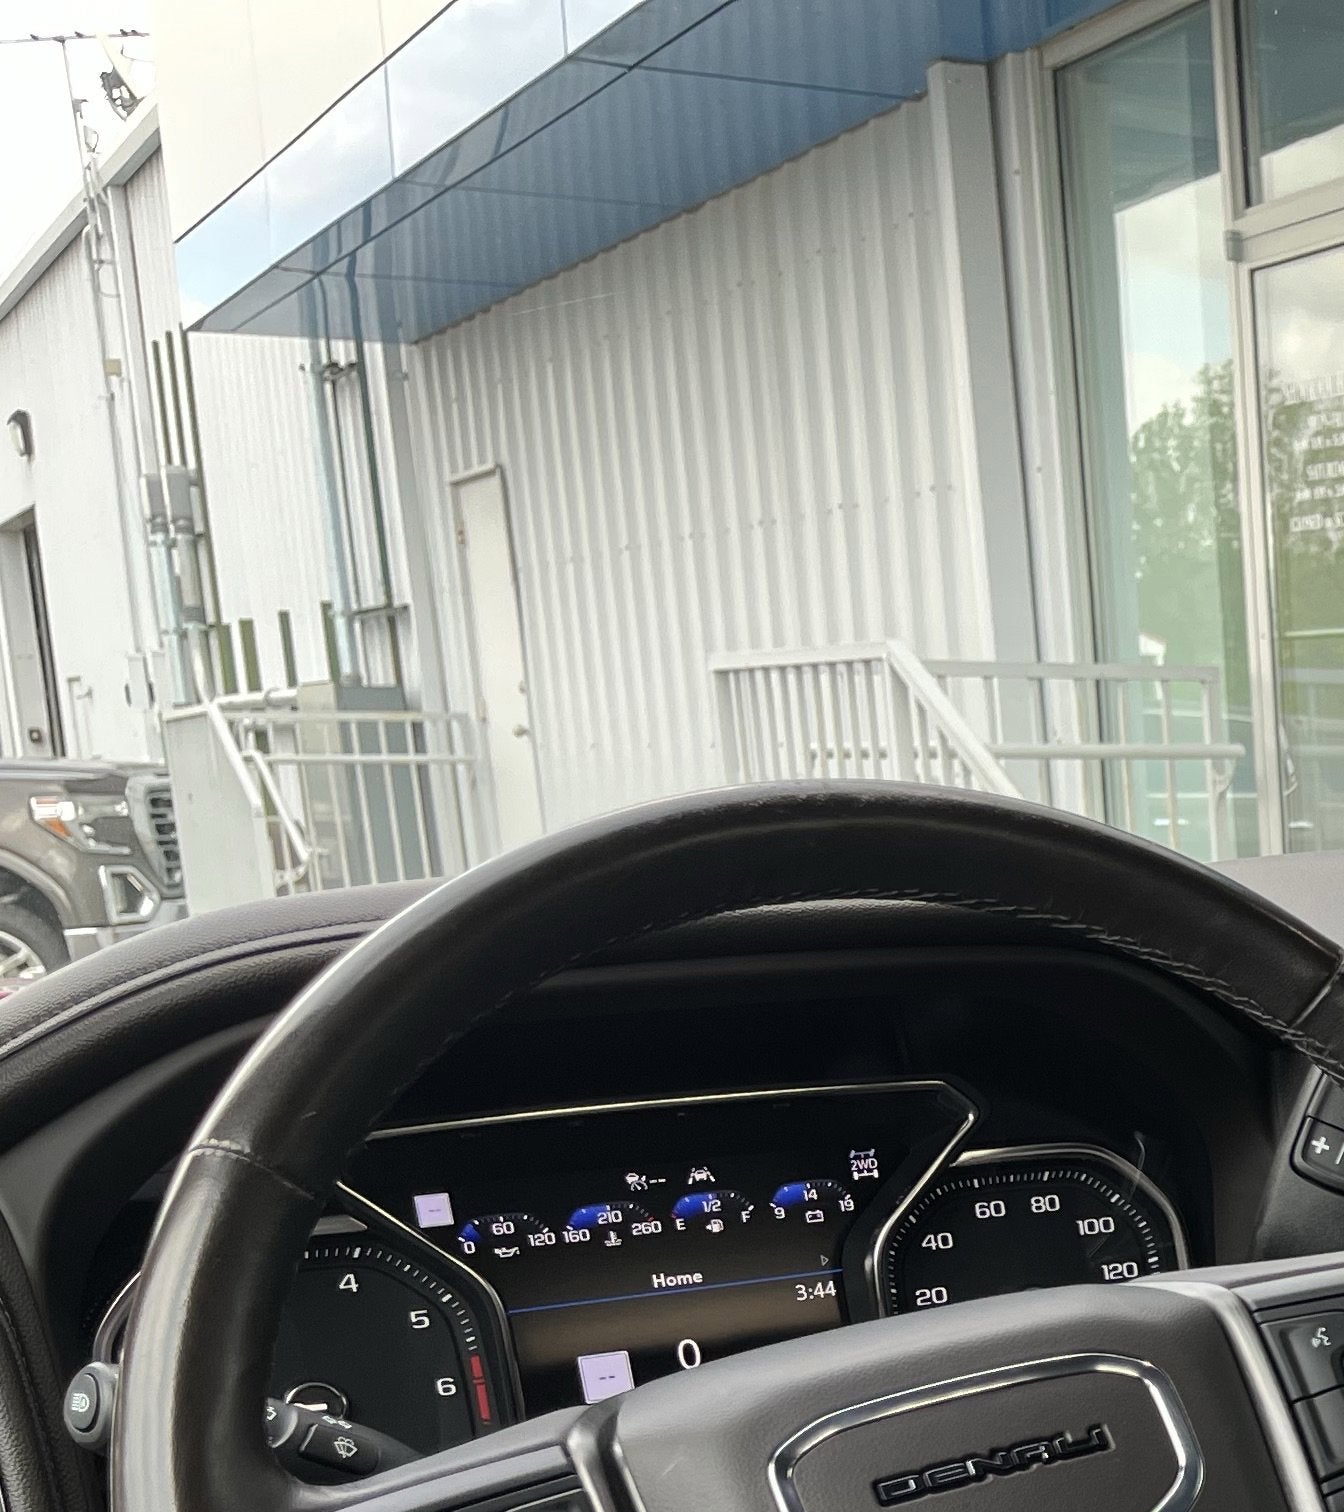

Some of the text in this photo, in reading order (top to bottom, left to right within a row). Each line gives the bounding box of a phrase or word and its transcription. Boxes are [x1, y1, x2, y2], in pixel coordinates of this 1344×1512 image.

[850, 1157, 878, 1172] 2WD
[803, 1188, 819, 1202] 14
[1030, 1193, 1061, 1214] 80
[702, 1199, 722, 1213] 1/2
[774, 1206, 786, 1220] 9
[838, 1199, 855, 1213] 19
[974, 1199, 1007, 1220] 60
[597, 1209, 623, 1225] 210
[675, 1218, 688, 1231] E
[741, 1210, 752, 1223] F
[491, 1220, 515, 1236] 60
[632, 1220, 662, 1236] 260
[1075, 1215, 1116, 1237] 100
[528, 1231, 556, 1248] 120
[562, 1228, 591, 1243] 160
[920, 1231, 954, 1250] 40
[463, 1240, 476, 1254] 0
[1101, 1260, 1139, 1281] 120
[337, 1273, 360, 1294] 4
[652, 1271, 704, 1289] Home
[794, 1279, 838, 1302] 3:44
[914, 1286, 948, 1306] 20
[408, 1310, 431, 1330] 5
[676, 1337, 702, 1371] 0
[435, 1376, 458, 1398] 6
[872, 1424, 1116, 1508] DENALI
